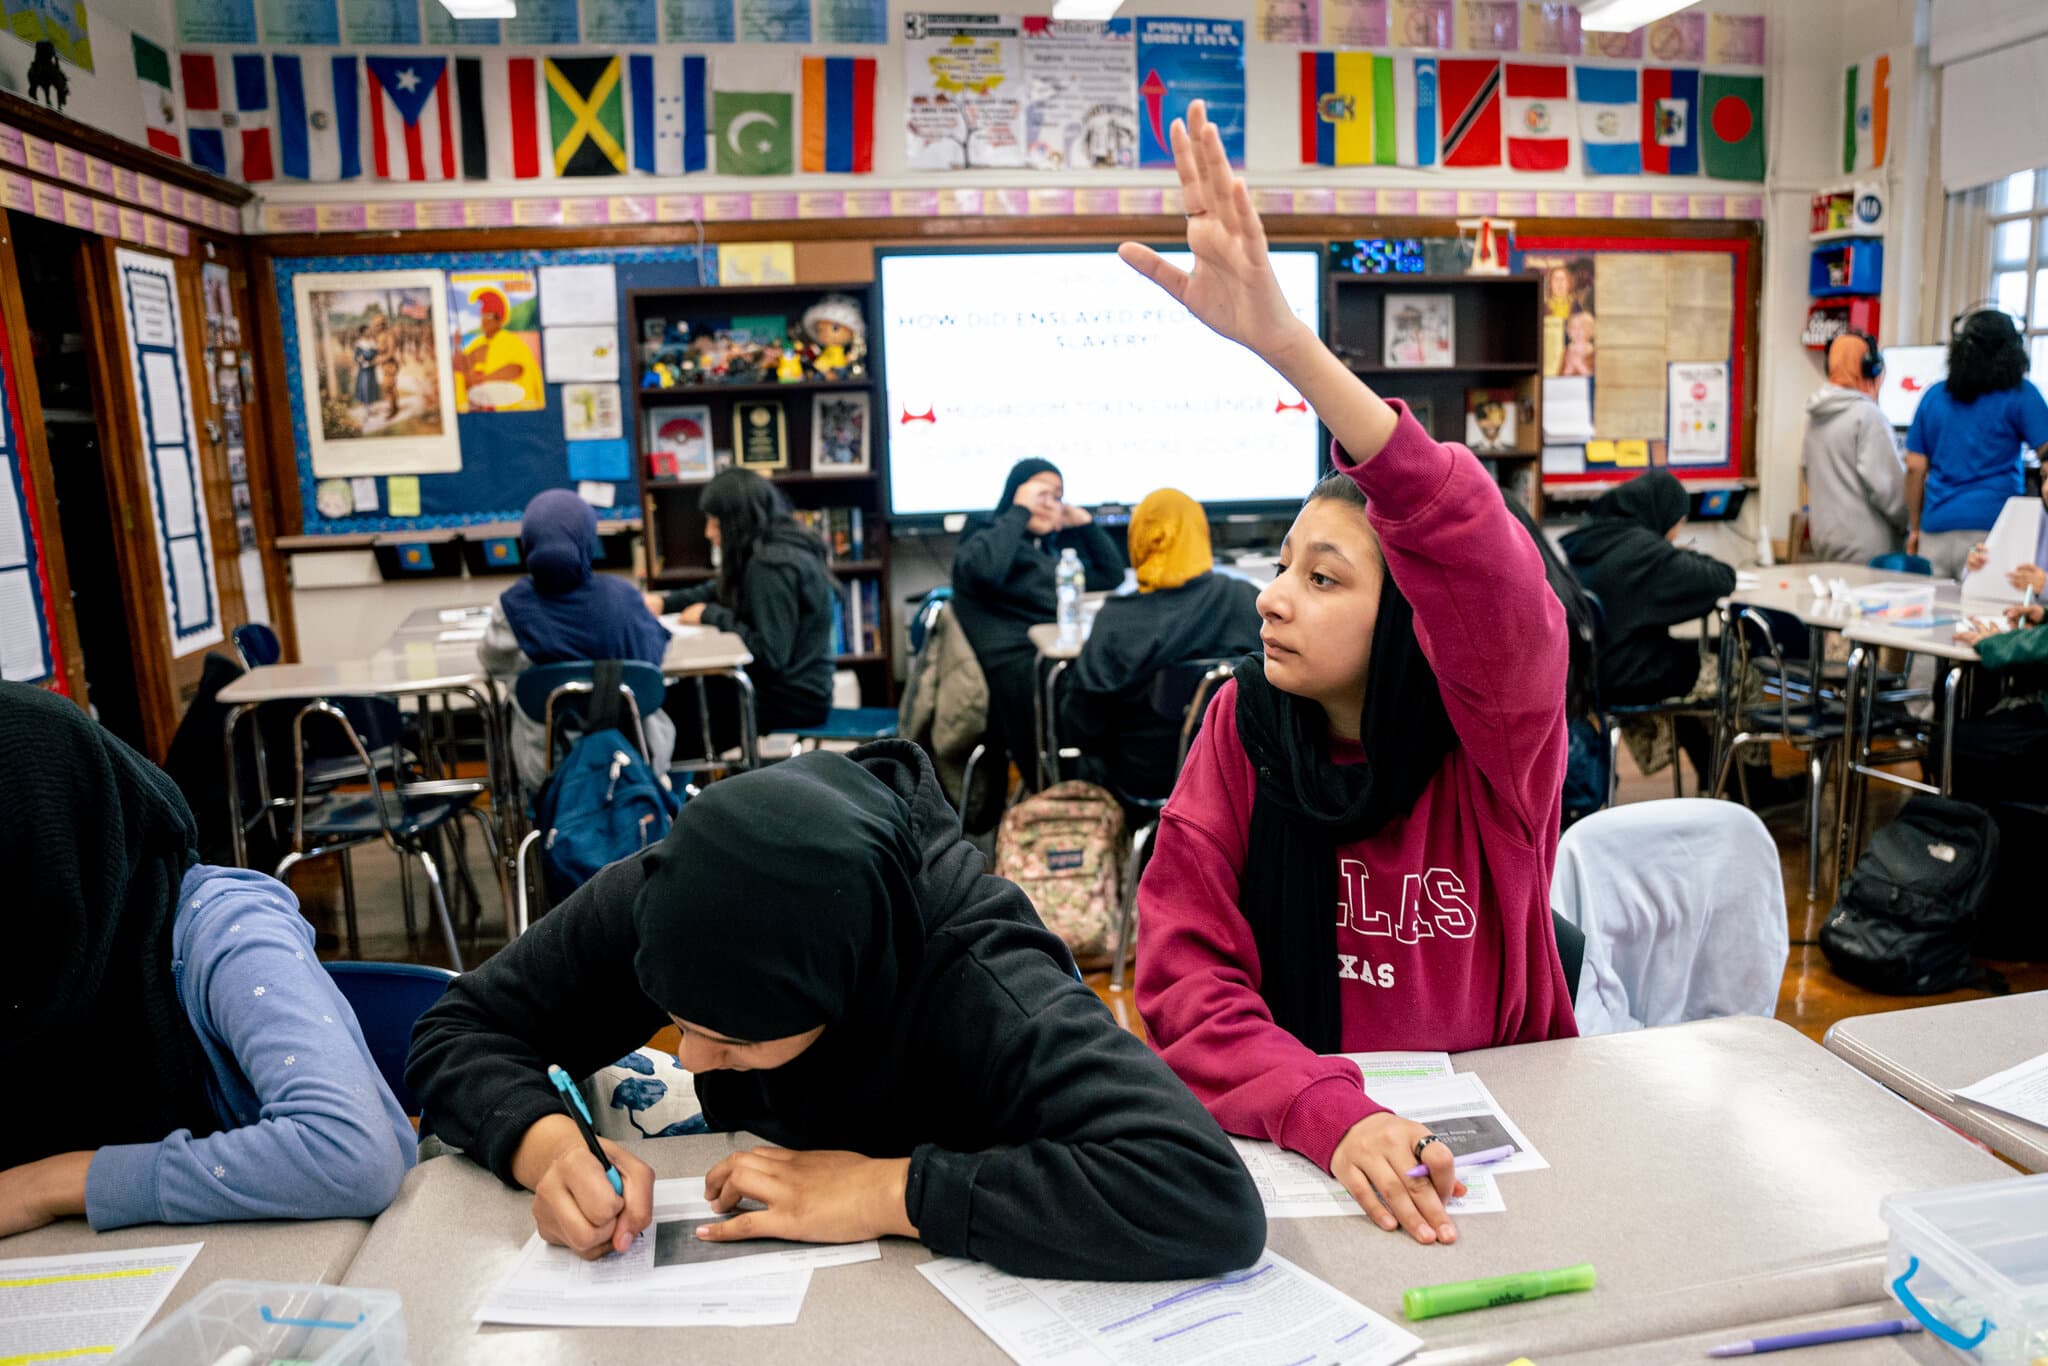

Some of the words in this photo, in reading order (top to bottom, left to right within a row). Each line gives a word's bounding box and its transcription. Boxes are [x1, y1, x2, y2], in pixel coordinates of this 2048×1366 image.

[897, 312, 957, 329] HOW
[967, 311, 1009, 328] DID
[1015, 309, 1133, 328] ENSLAVED
[1336, 859, 1477, 945] LAS
[1337, 954, 1395, 989] XAS
